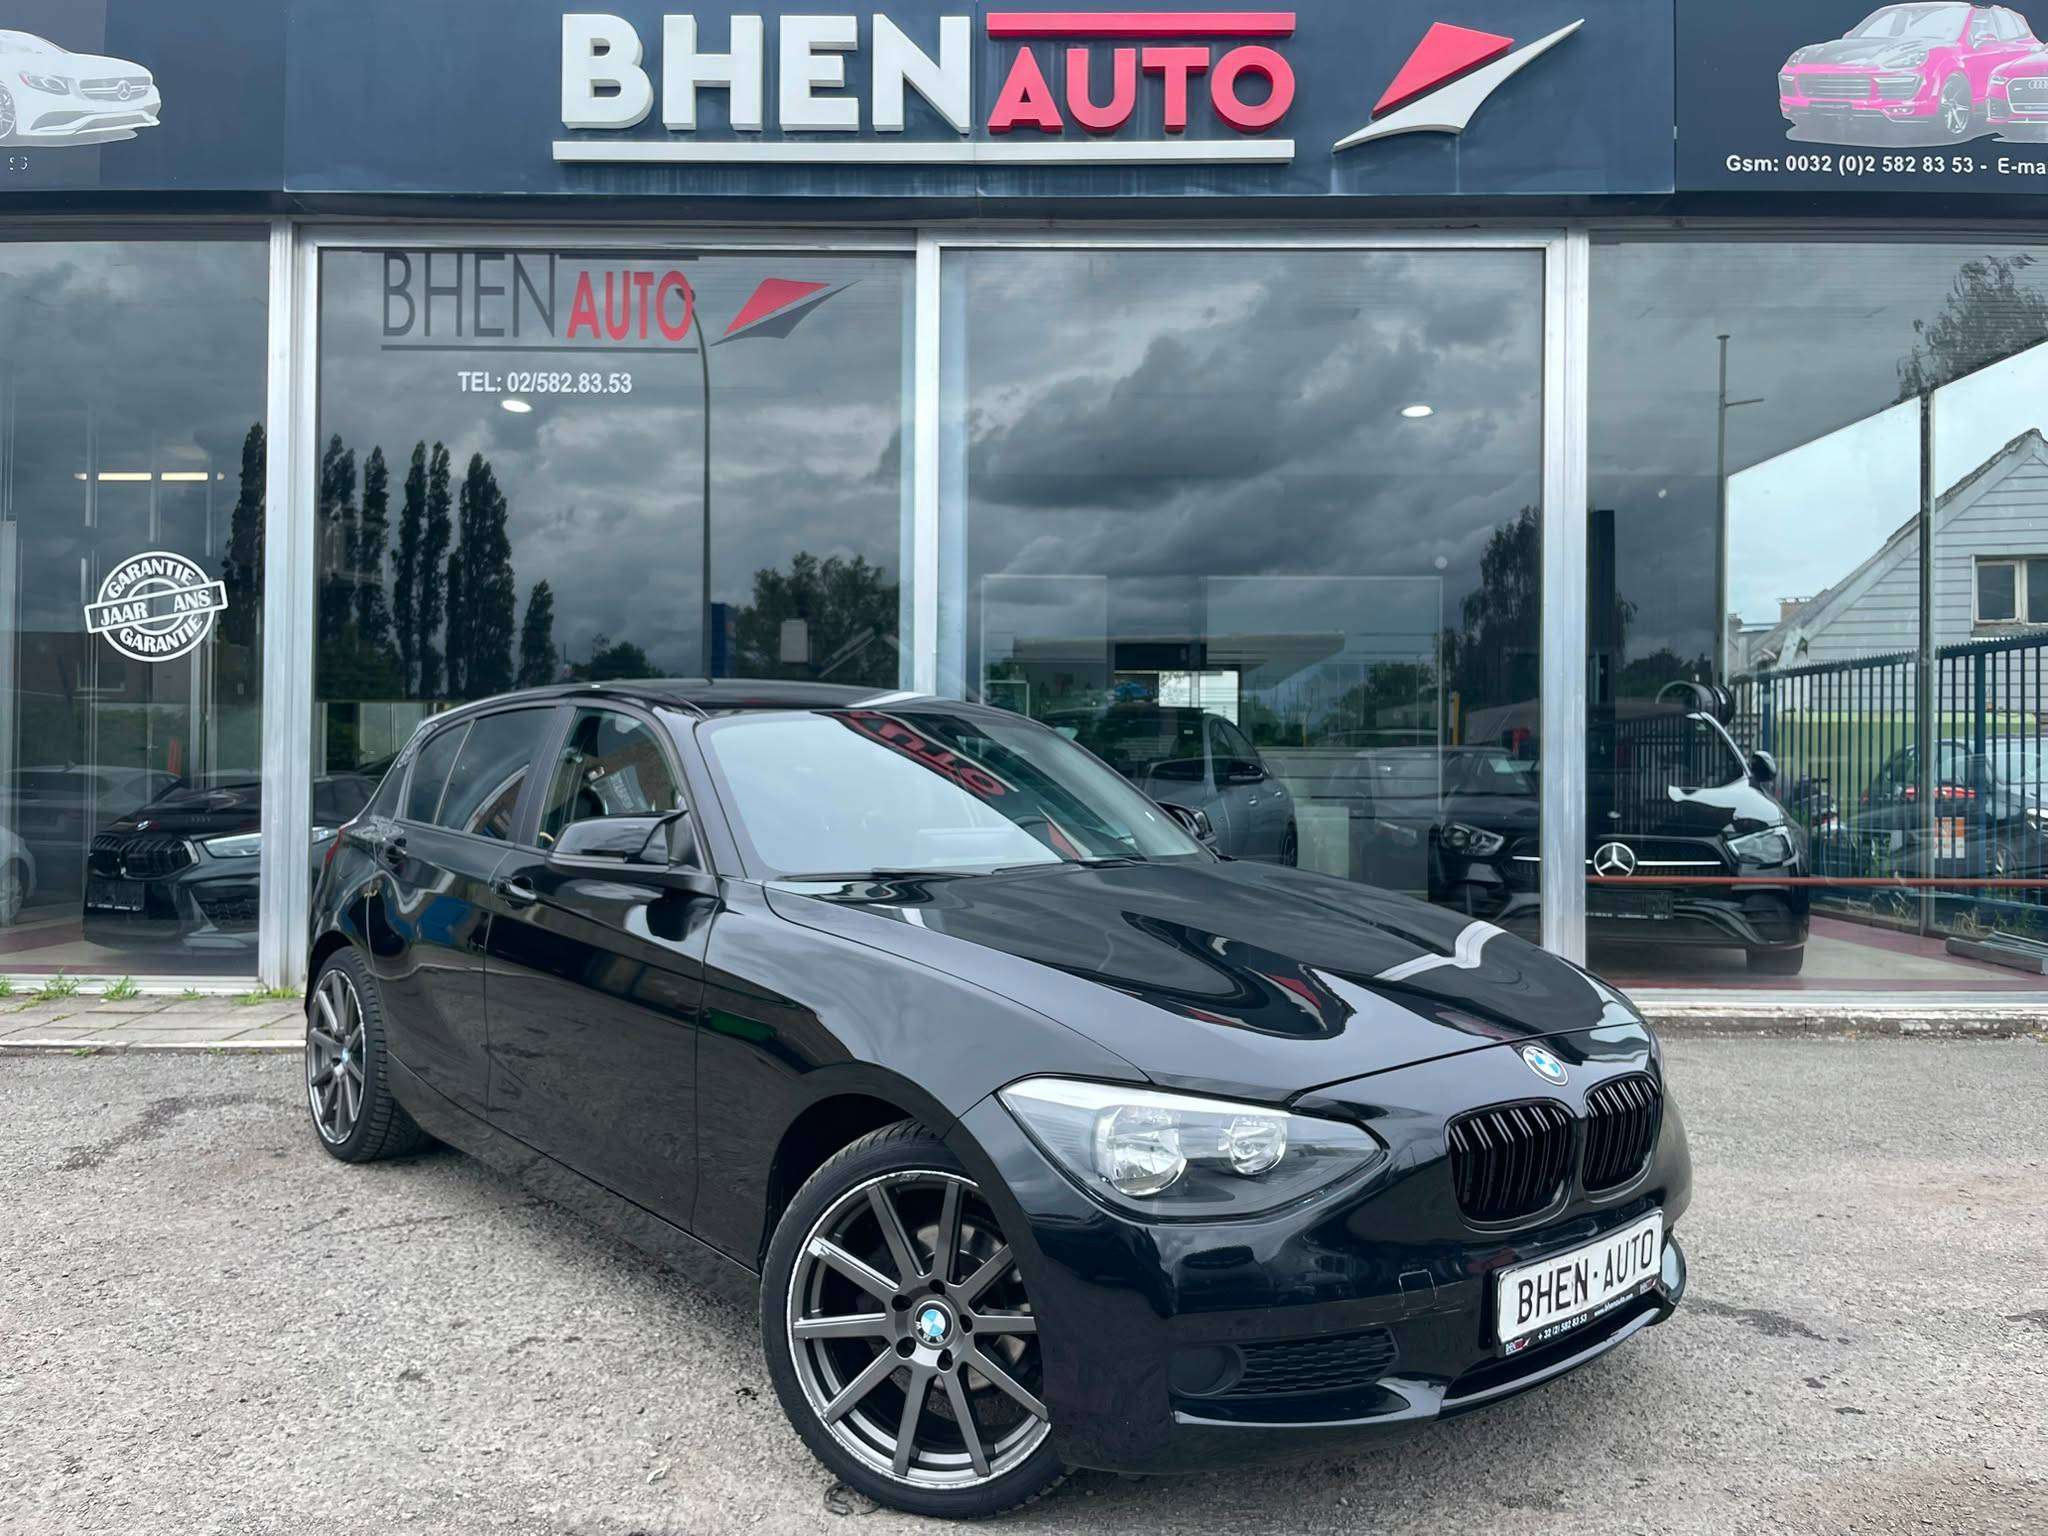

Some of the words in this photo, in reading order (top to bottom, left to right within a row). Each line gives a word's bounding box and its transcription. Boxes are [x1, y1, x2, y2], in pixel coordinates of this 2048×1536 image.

[562, 14, 971, 134] BHEN
[988, 45, 1296, 133] AUTO
[1726, 155, 1779, 172] Gsm:
[1785, 155, 1832, 172] 0032
[1838, 155, 1876, 176] (0)2
[1881, 155, 1917, 173] 582
[1922, 156, 1946, 173] 83
[1951, 157, 1974, 174] 53
[383, 251, 556, 338] BHEN
[567, 270, 694, 342] AUTO
[458, 371, 503, 394] TEL:
[507, 371, 633, 395] 02/582.83.53
[107, 558, 196, 599] GARANTIE
[100, 601, 149, 627] JAAR
[173, 589, 212, 613] ANS
[119, 613, 204, 653] GARANTIE
